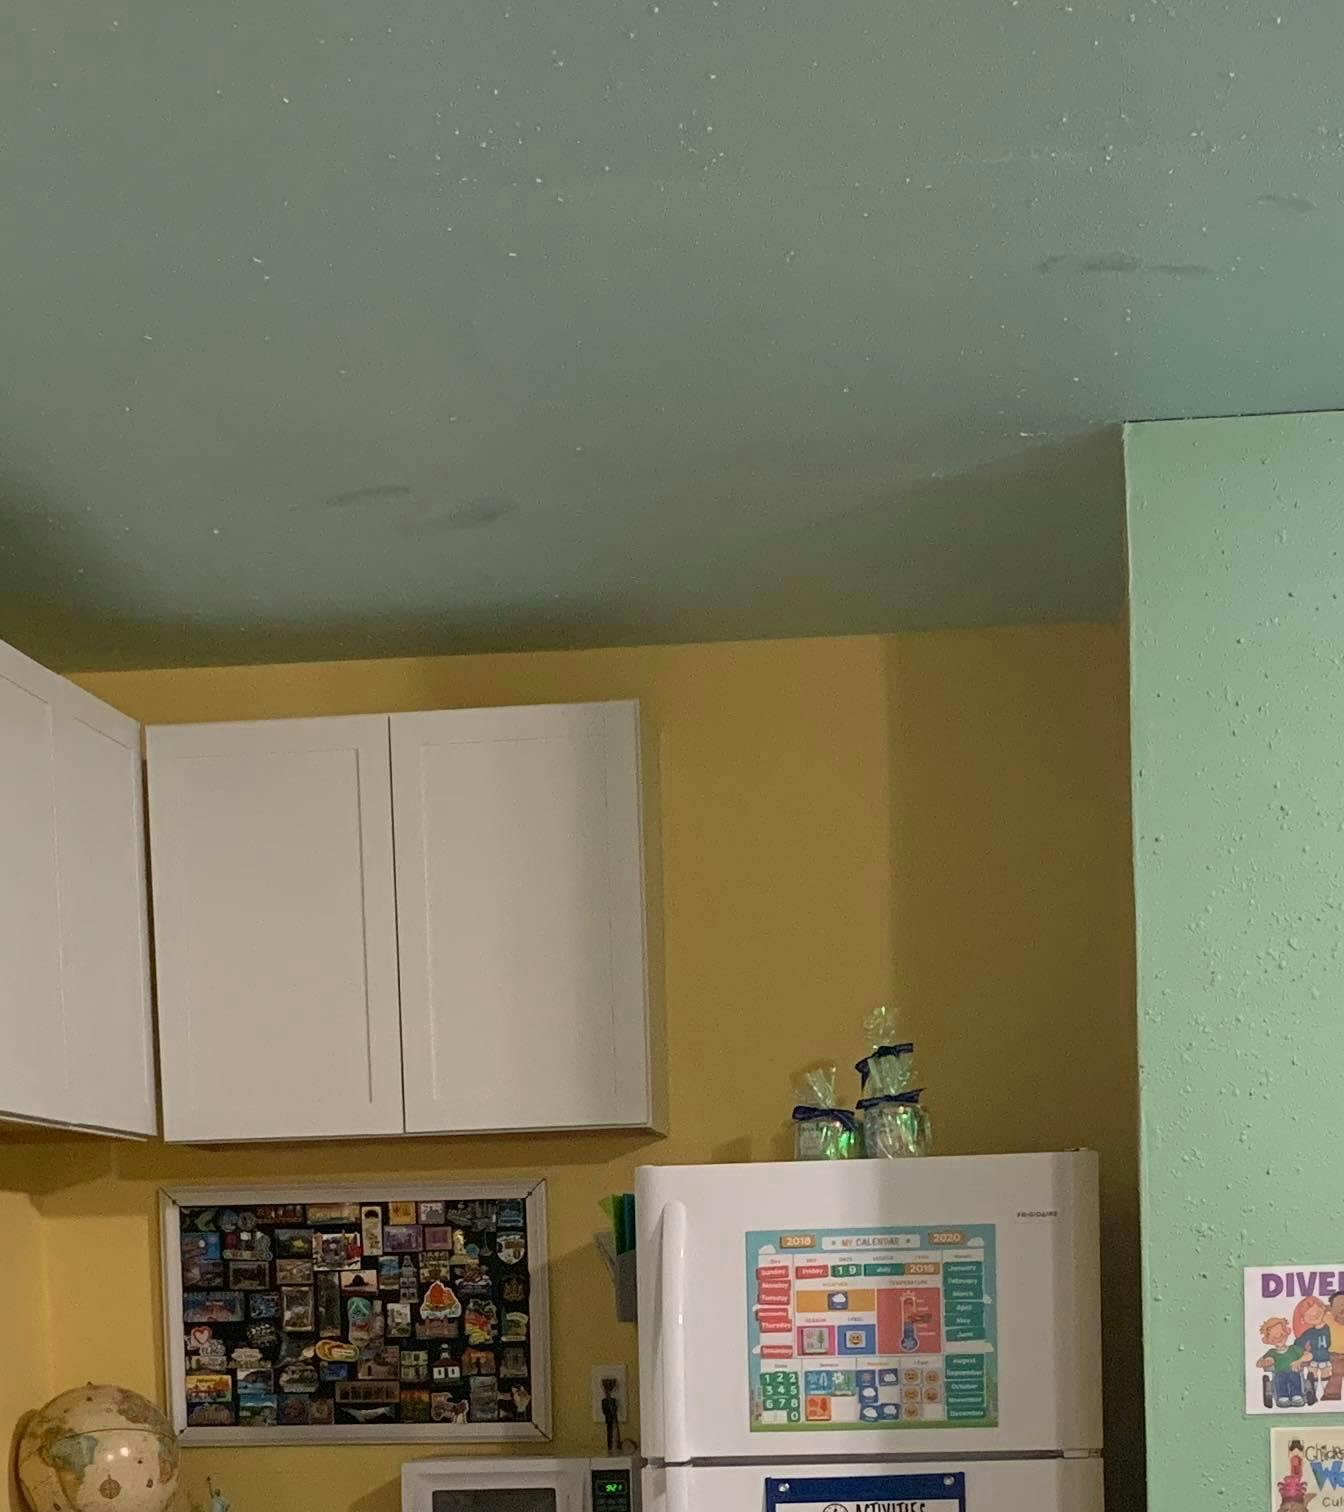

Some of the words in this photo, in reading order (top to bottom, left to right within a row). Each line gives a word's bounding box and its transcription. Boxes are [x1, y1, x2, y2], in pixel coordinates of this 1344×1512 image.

[787, 1237, 811, 1246] 2018
[856, 1237, 900, 1246] CALENDAR
[932, 1232, 961, 1244] 2020
[910, 1264, 934, 1273] 2019
